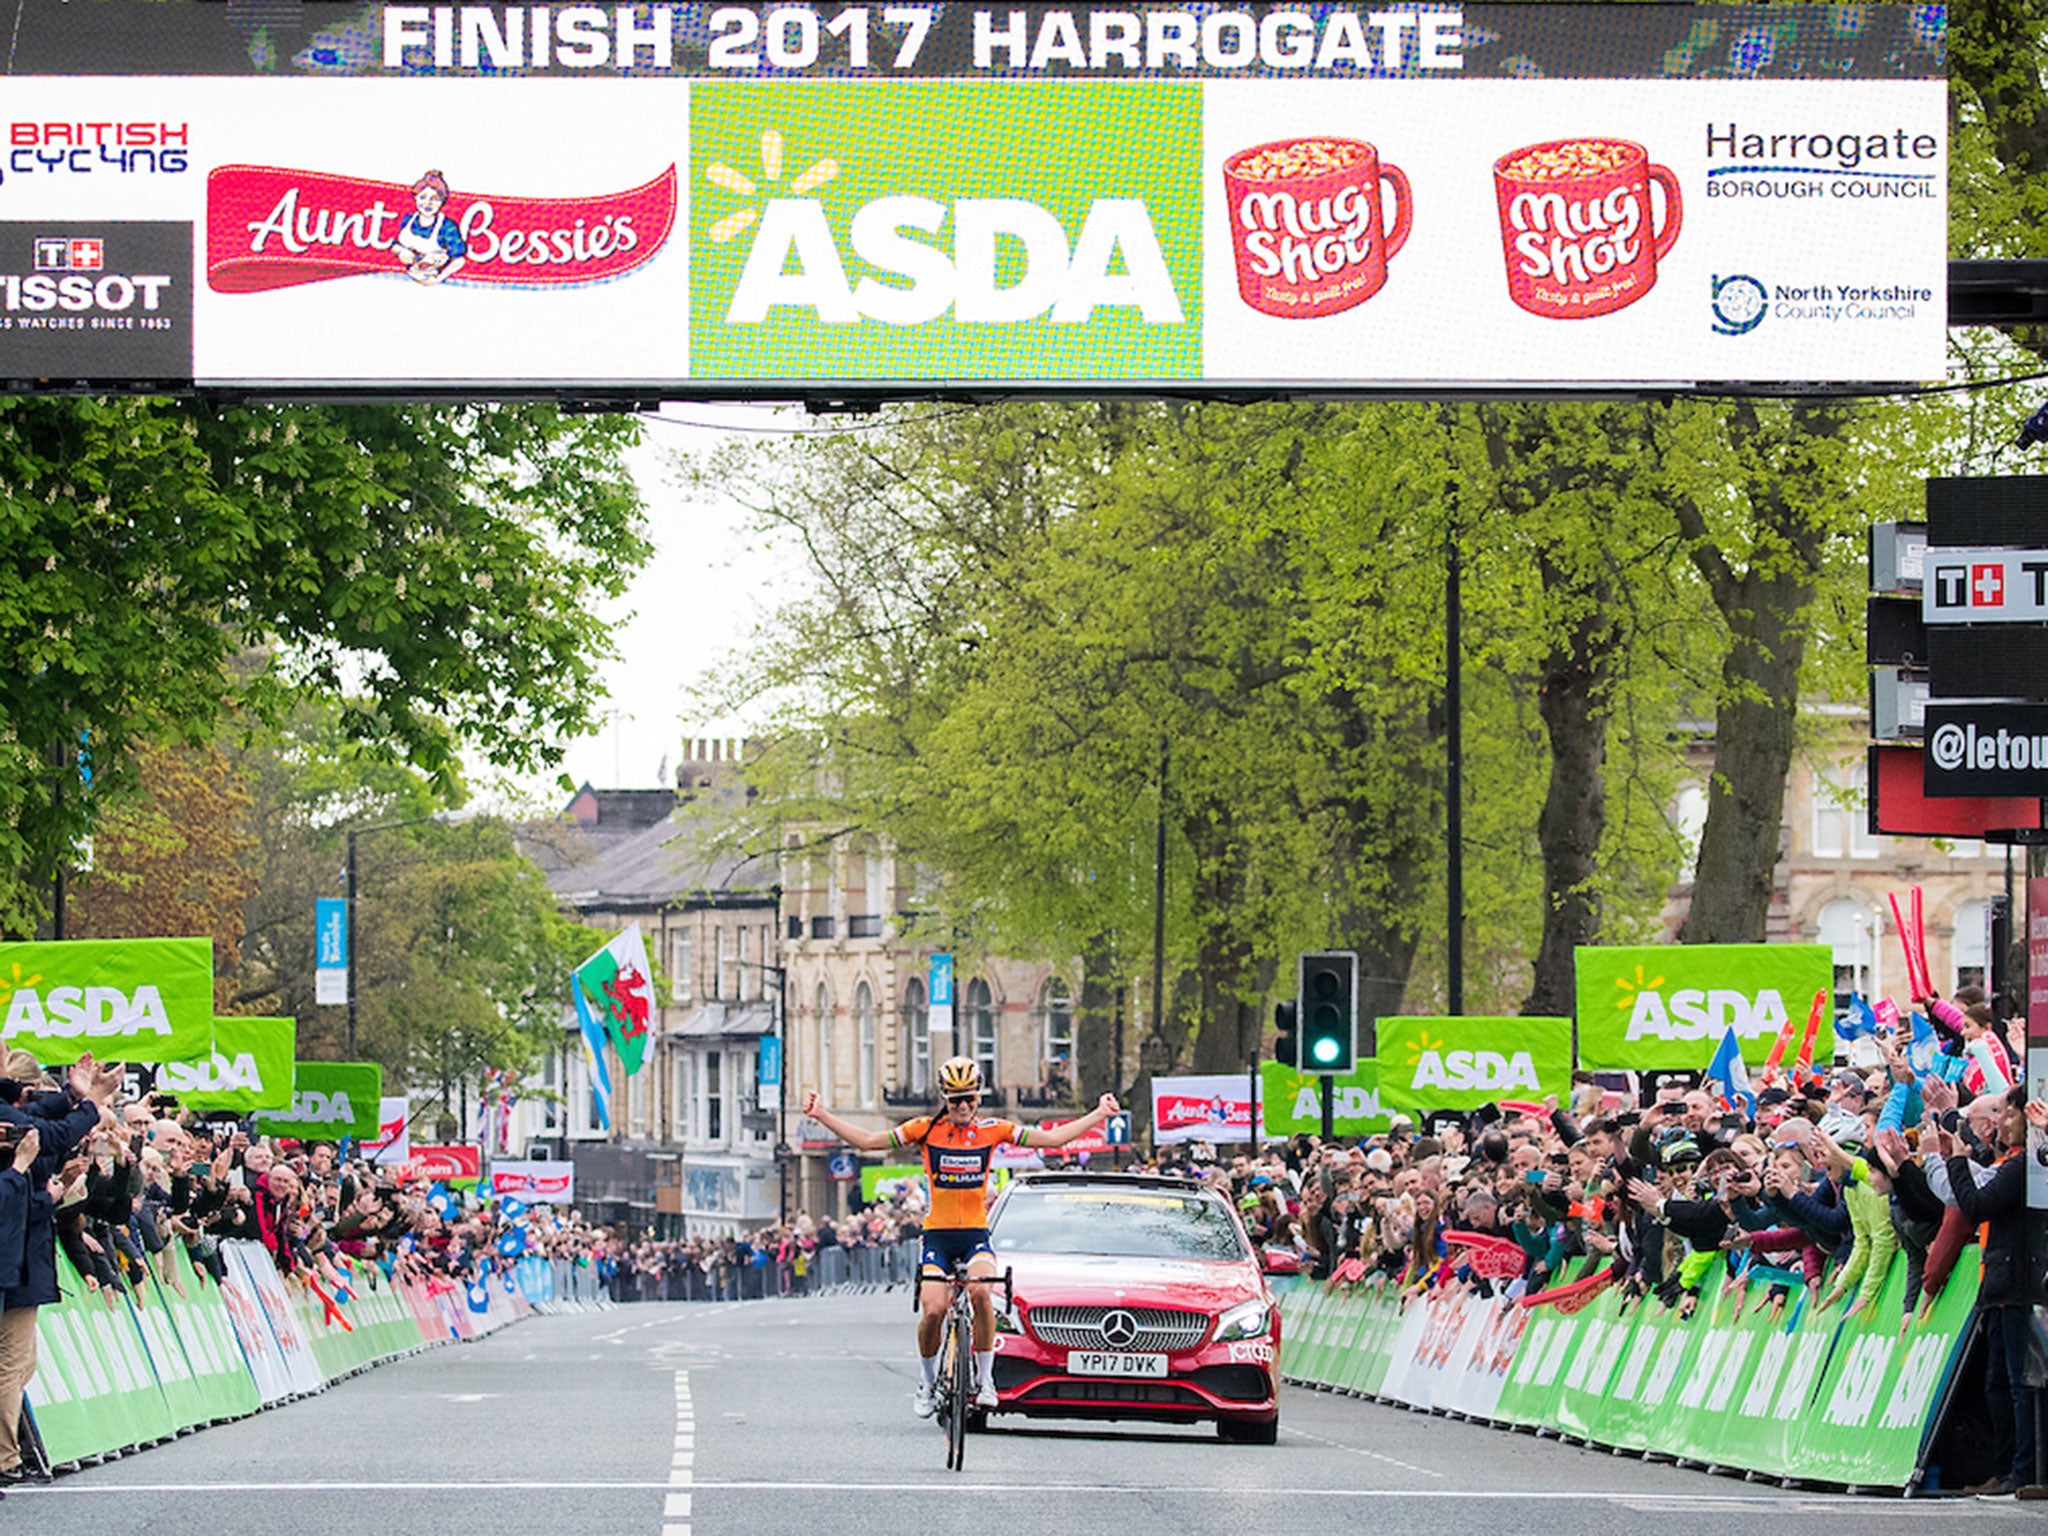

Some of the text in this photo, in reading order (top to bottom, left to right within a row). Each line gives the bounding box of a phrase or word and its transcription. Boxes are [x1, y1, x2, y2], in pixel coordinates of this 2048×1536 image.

[384, 7, 1464, 70] FINISH 2017 HARROGATE
[11, 122, 188, 146] BRITISH
[1707, 123, 1937, 168] Harrogate
[1241, 185, 1371, 239] Mug
[1510, 185, 1642, 239] Mug
[1707, 181, 1937, 198] BOROUGH COUNCIL
[247, 188, 638, 263] Aunt Bessie's
[725, 193, 1186, 324] ASDA
[1245, 224, 1371, 285] Shot
[1514, 224, 1641, 285] Shot
[1775, 285, 1932, 301] North Yorkshire
[1775, 303, 1915, 322] County Council
[18, 317, 84, 330] WATCHES
[91, 317, 134, 330] SINCE
[2, 985, 173, 1039] ASDA
[1625, 988, 1790, 1041] ASDA
[1410, 1050, 1541, 1091] ASDA
[1168, 1100, 1208, 1120] Aunt
[1292, 1087, 1396, 1119] ASD
[1080, 1354, 1157, 1373] YP17 DVK
